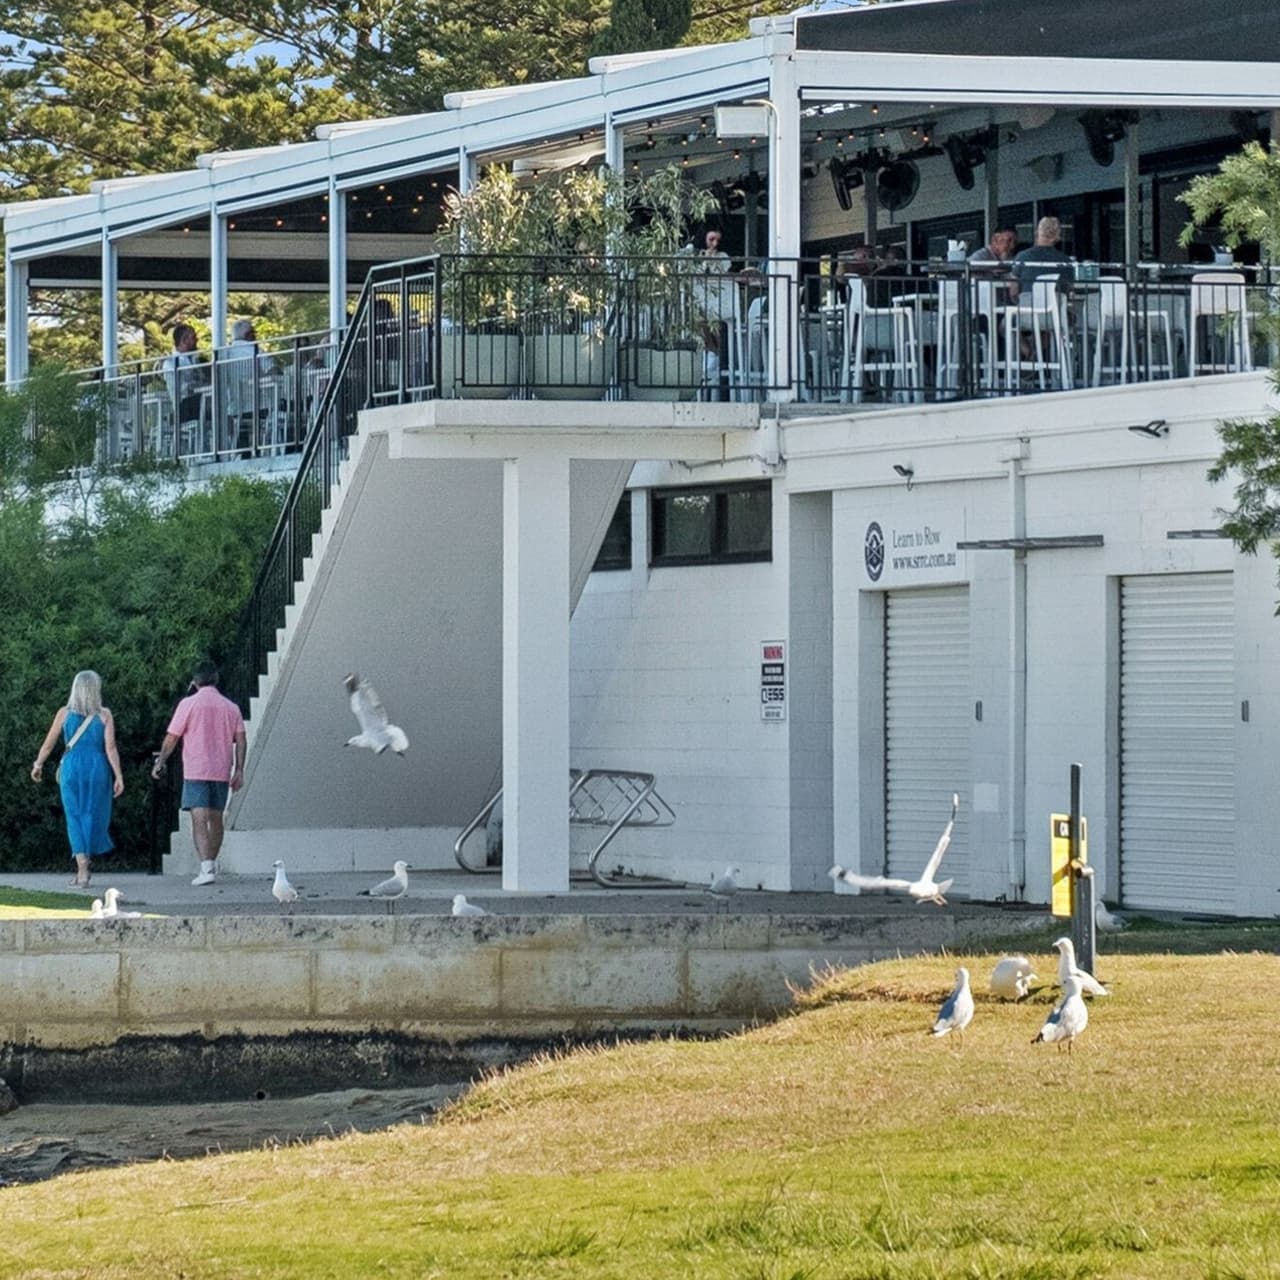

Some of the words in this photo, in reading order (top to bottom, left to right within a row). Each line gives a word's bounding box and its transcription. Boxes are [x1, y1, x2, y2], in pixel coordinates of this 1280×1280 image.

[892, 529, 914, 548] Learn
[915, 531, 923, 546] to
[924, 526, 941, 546] Row
